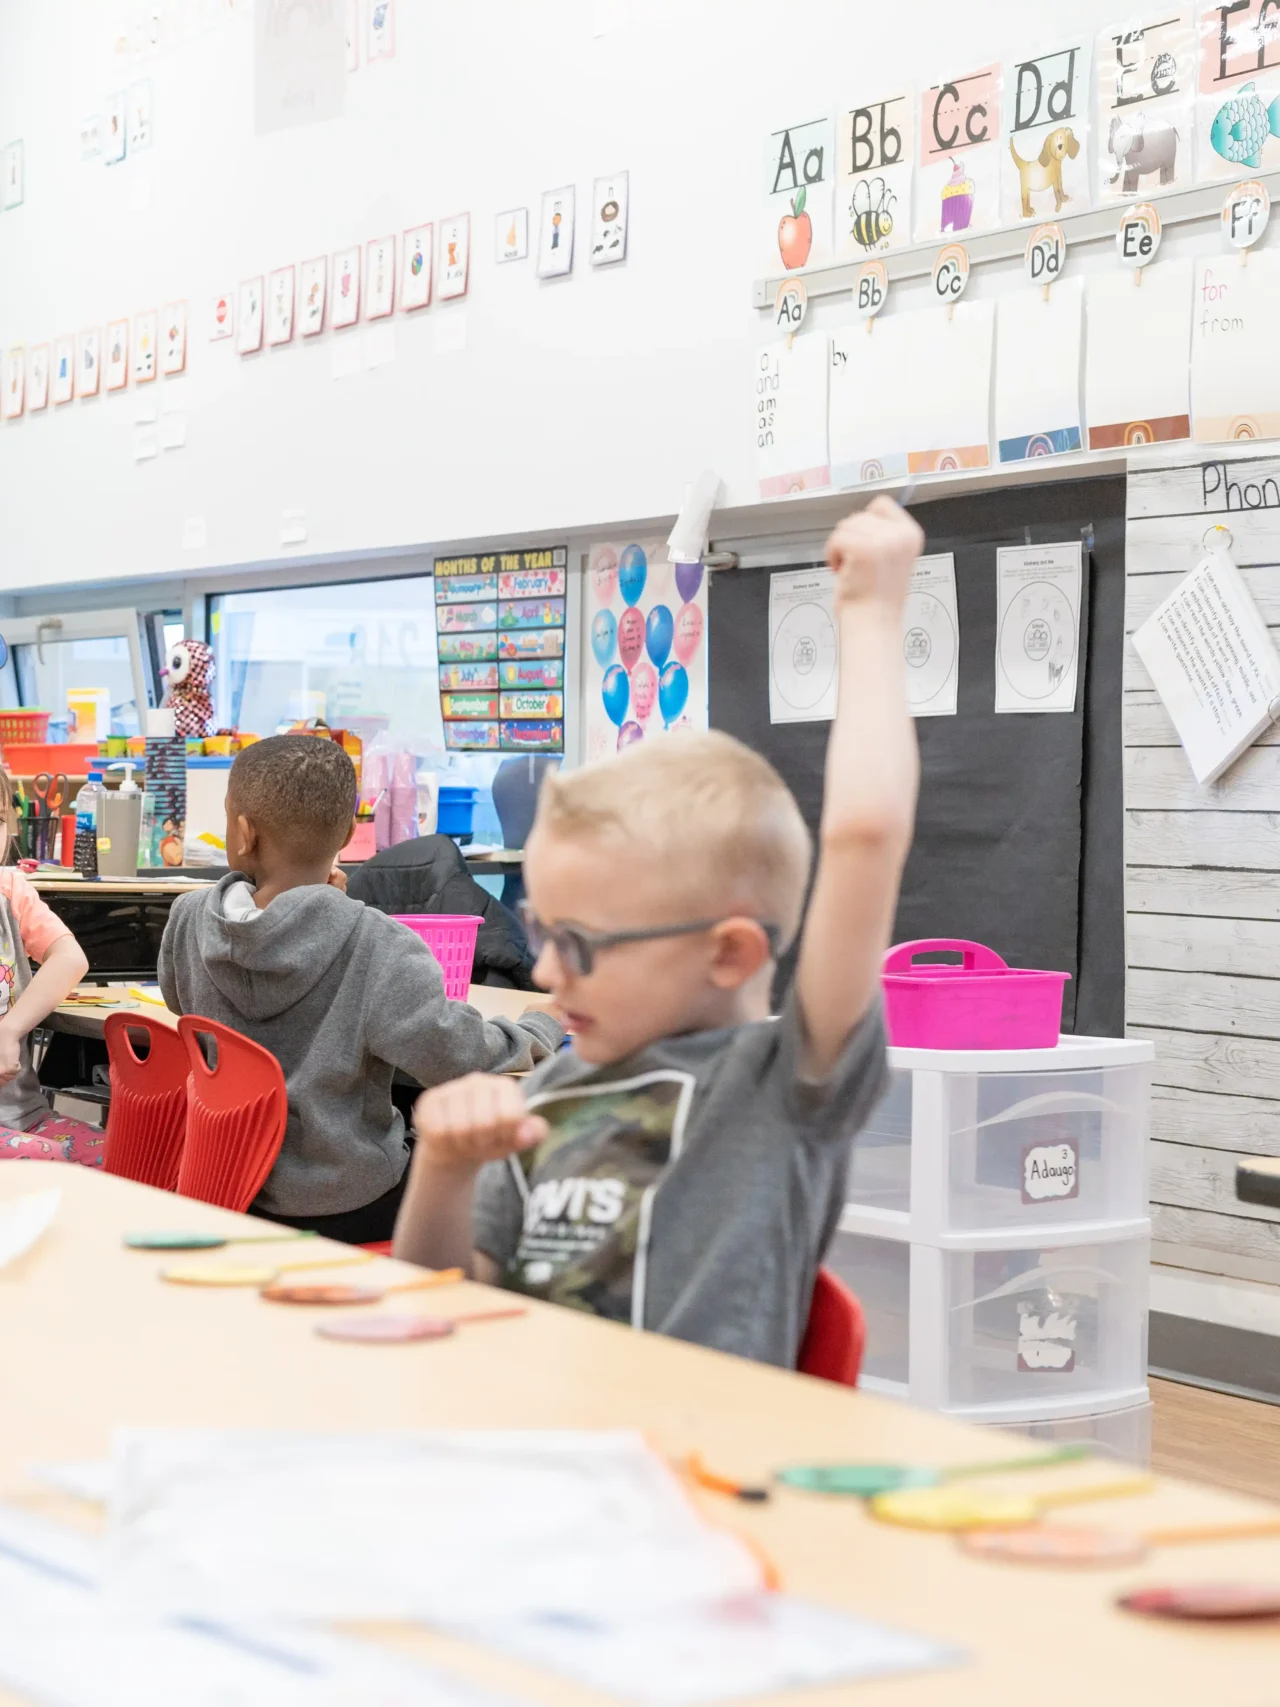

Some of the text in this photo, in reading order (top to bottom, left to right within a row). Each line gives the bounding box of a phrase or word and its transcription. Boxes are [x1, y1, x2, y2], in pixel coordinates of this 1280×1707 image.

[1116, 31, 1178, 107] Ee
[1015, 50, 1076, 130] Dd
[933, 83, 988, 149] Cc
[852, 102, 902, 173] Bb
[773, 130, 824, 193] Aa
[1231, 198, 1261, 239] Ff
[1123, 222, 1153, 258] Ee
[1031, 239, 1059, 278] Dd
[858, 276, 882, 309] Bb
[936, 264, 962, 296] Cc
[1201, 269, 1228, 303] for
[777, 295, 802, 325] Aa
[1200, 309, 1244, 337] from
[760, 353, 770, 372] a
[831, 340, 849, 375] by
[757, 359, 780, 395] and
[757, 397, 777, 413] am
[758, 412, 775, 430] as
[757, 430, 774, 448] an
[435, 551, 552, 577] MONTHS OF THE YEAR
[514, 576, 548, 591] February
[518, 668, 543, 683] August
[516, 697, 546, 711] October
[1062, 1149, 1067, 1160] 3
[1031, 1160, 1074, 1186] Adaugo
